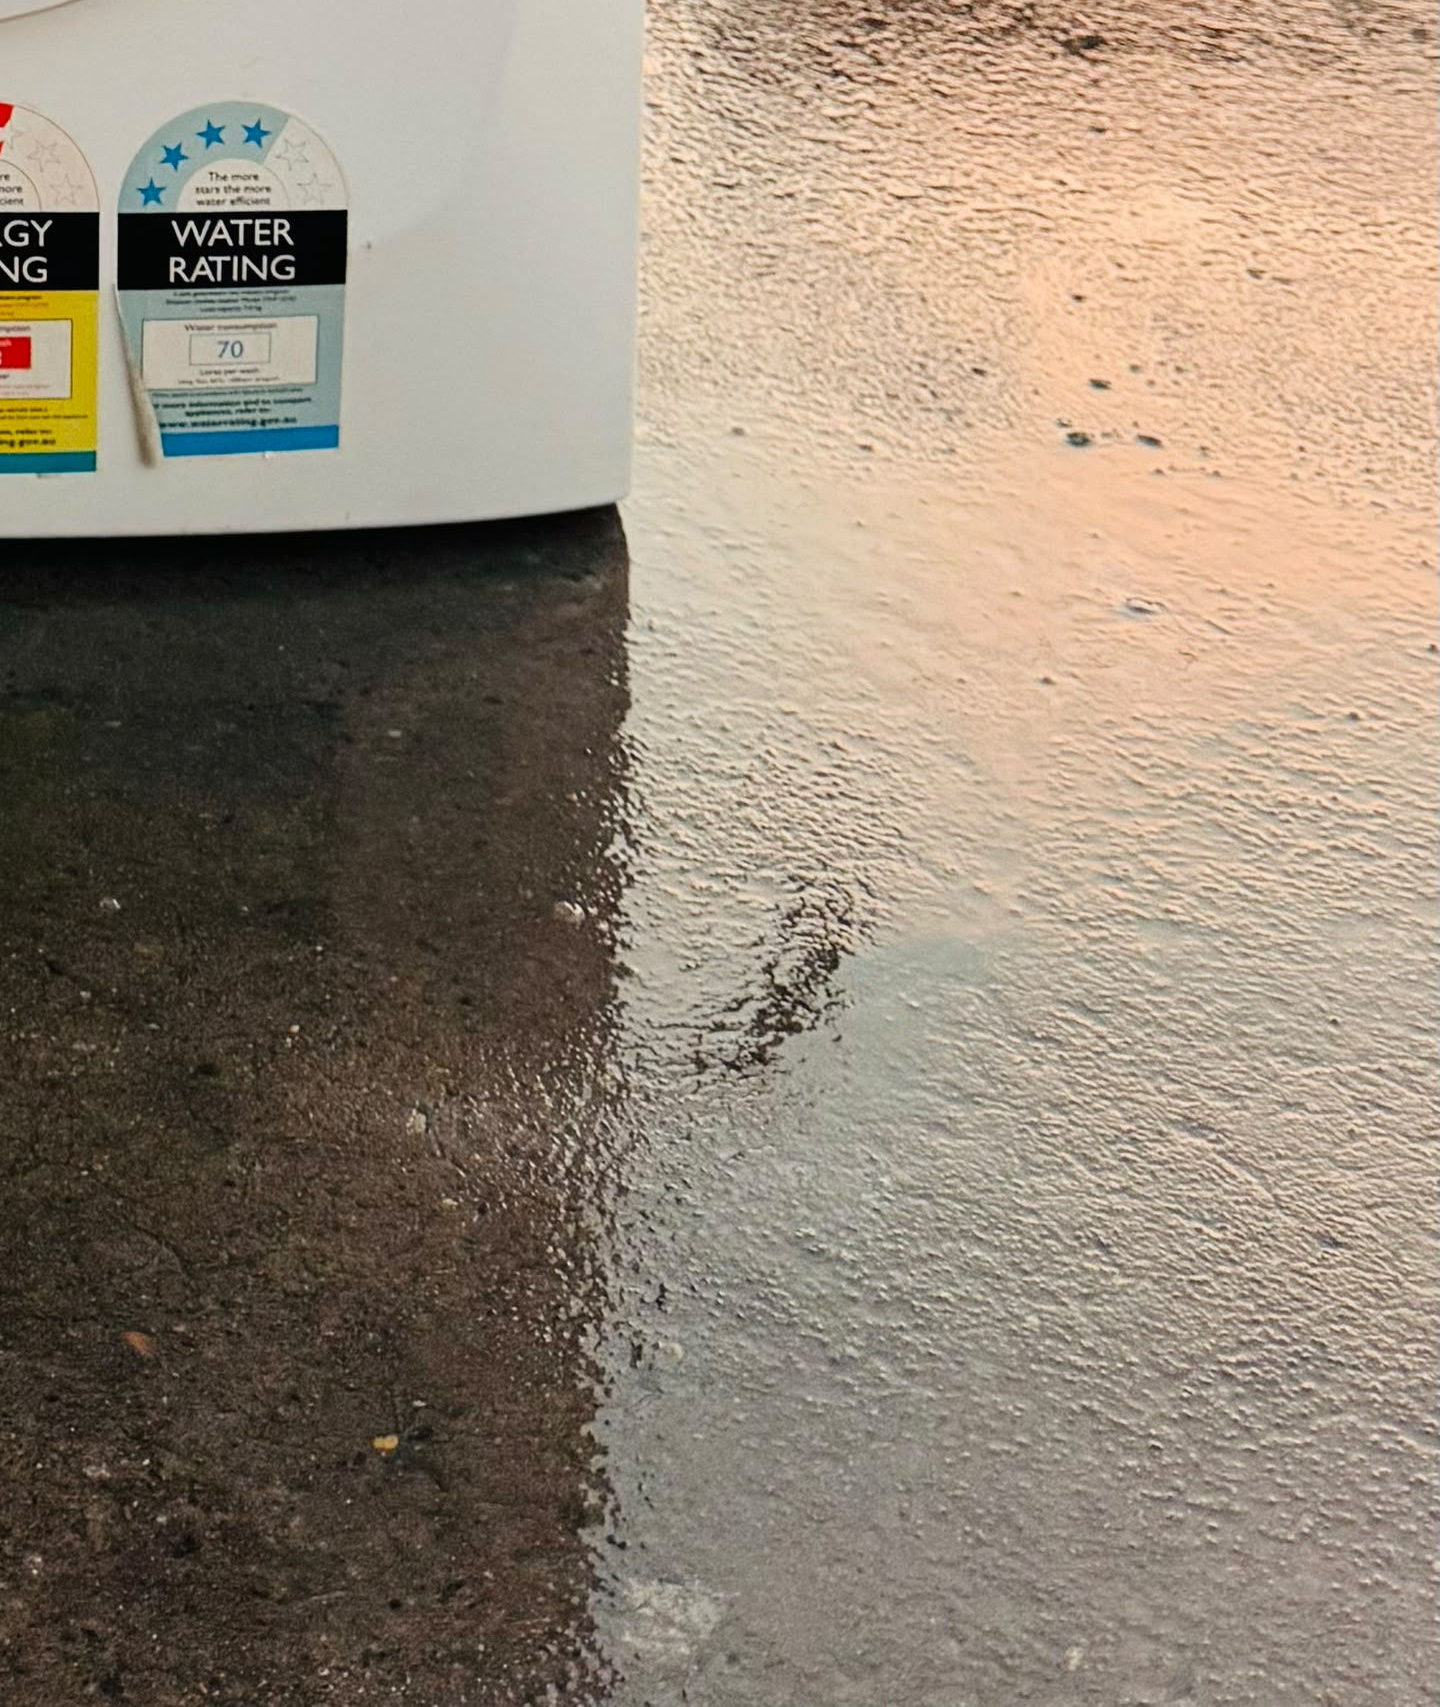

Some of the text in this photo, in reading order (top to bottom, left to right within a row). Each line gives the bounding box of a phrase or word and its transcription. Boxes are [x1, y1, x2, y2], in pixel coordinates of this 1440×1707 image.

[208, 171, 259, 182] The more
[195, 185, 272, 194] stars the more
[196, 196, 271, 207] water efficient
[171, 218, 295, 247] WATER
[169, 254, 296, 283] RATING
[184, 323, 214, 332] Water
[217, 340, 244, 358] 70
